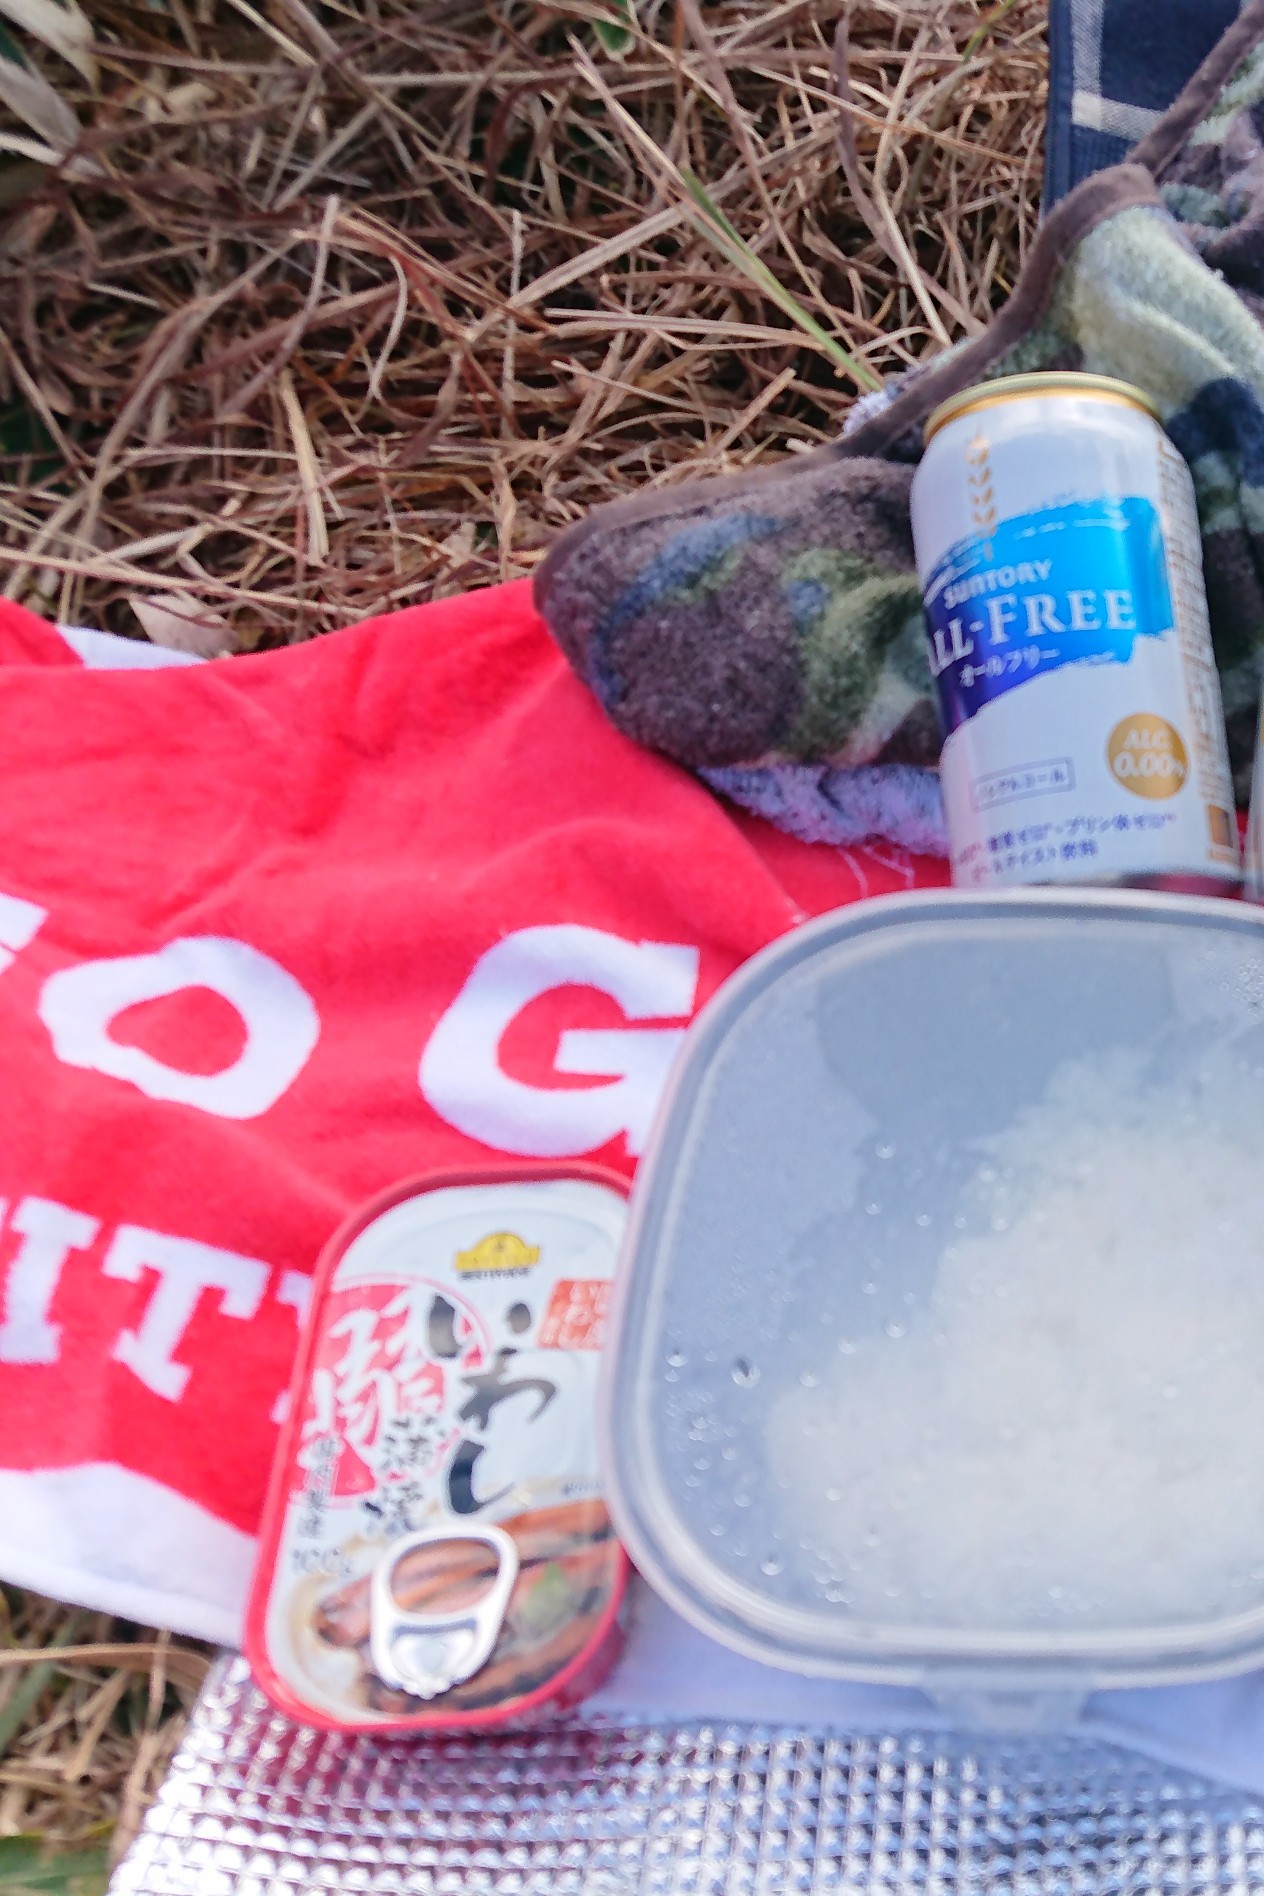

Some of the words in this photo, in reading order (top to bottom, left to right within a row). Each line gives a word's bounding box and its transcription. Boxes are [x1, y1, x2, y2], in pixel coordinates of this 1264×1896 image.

[943, 558, 1053, 610] SUNTORY
[426, 1292, 557, 1514] いわし
